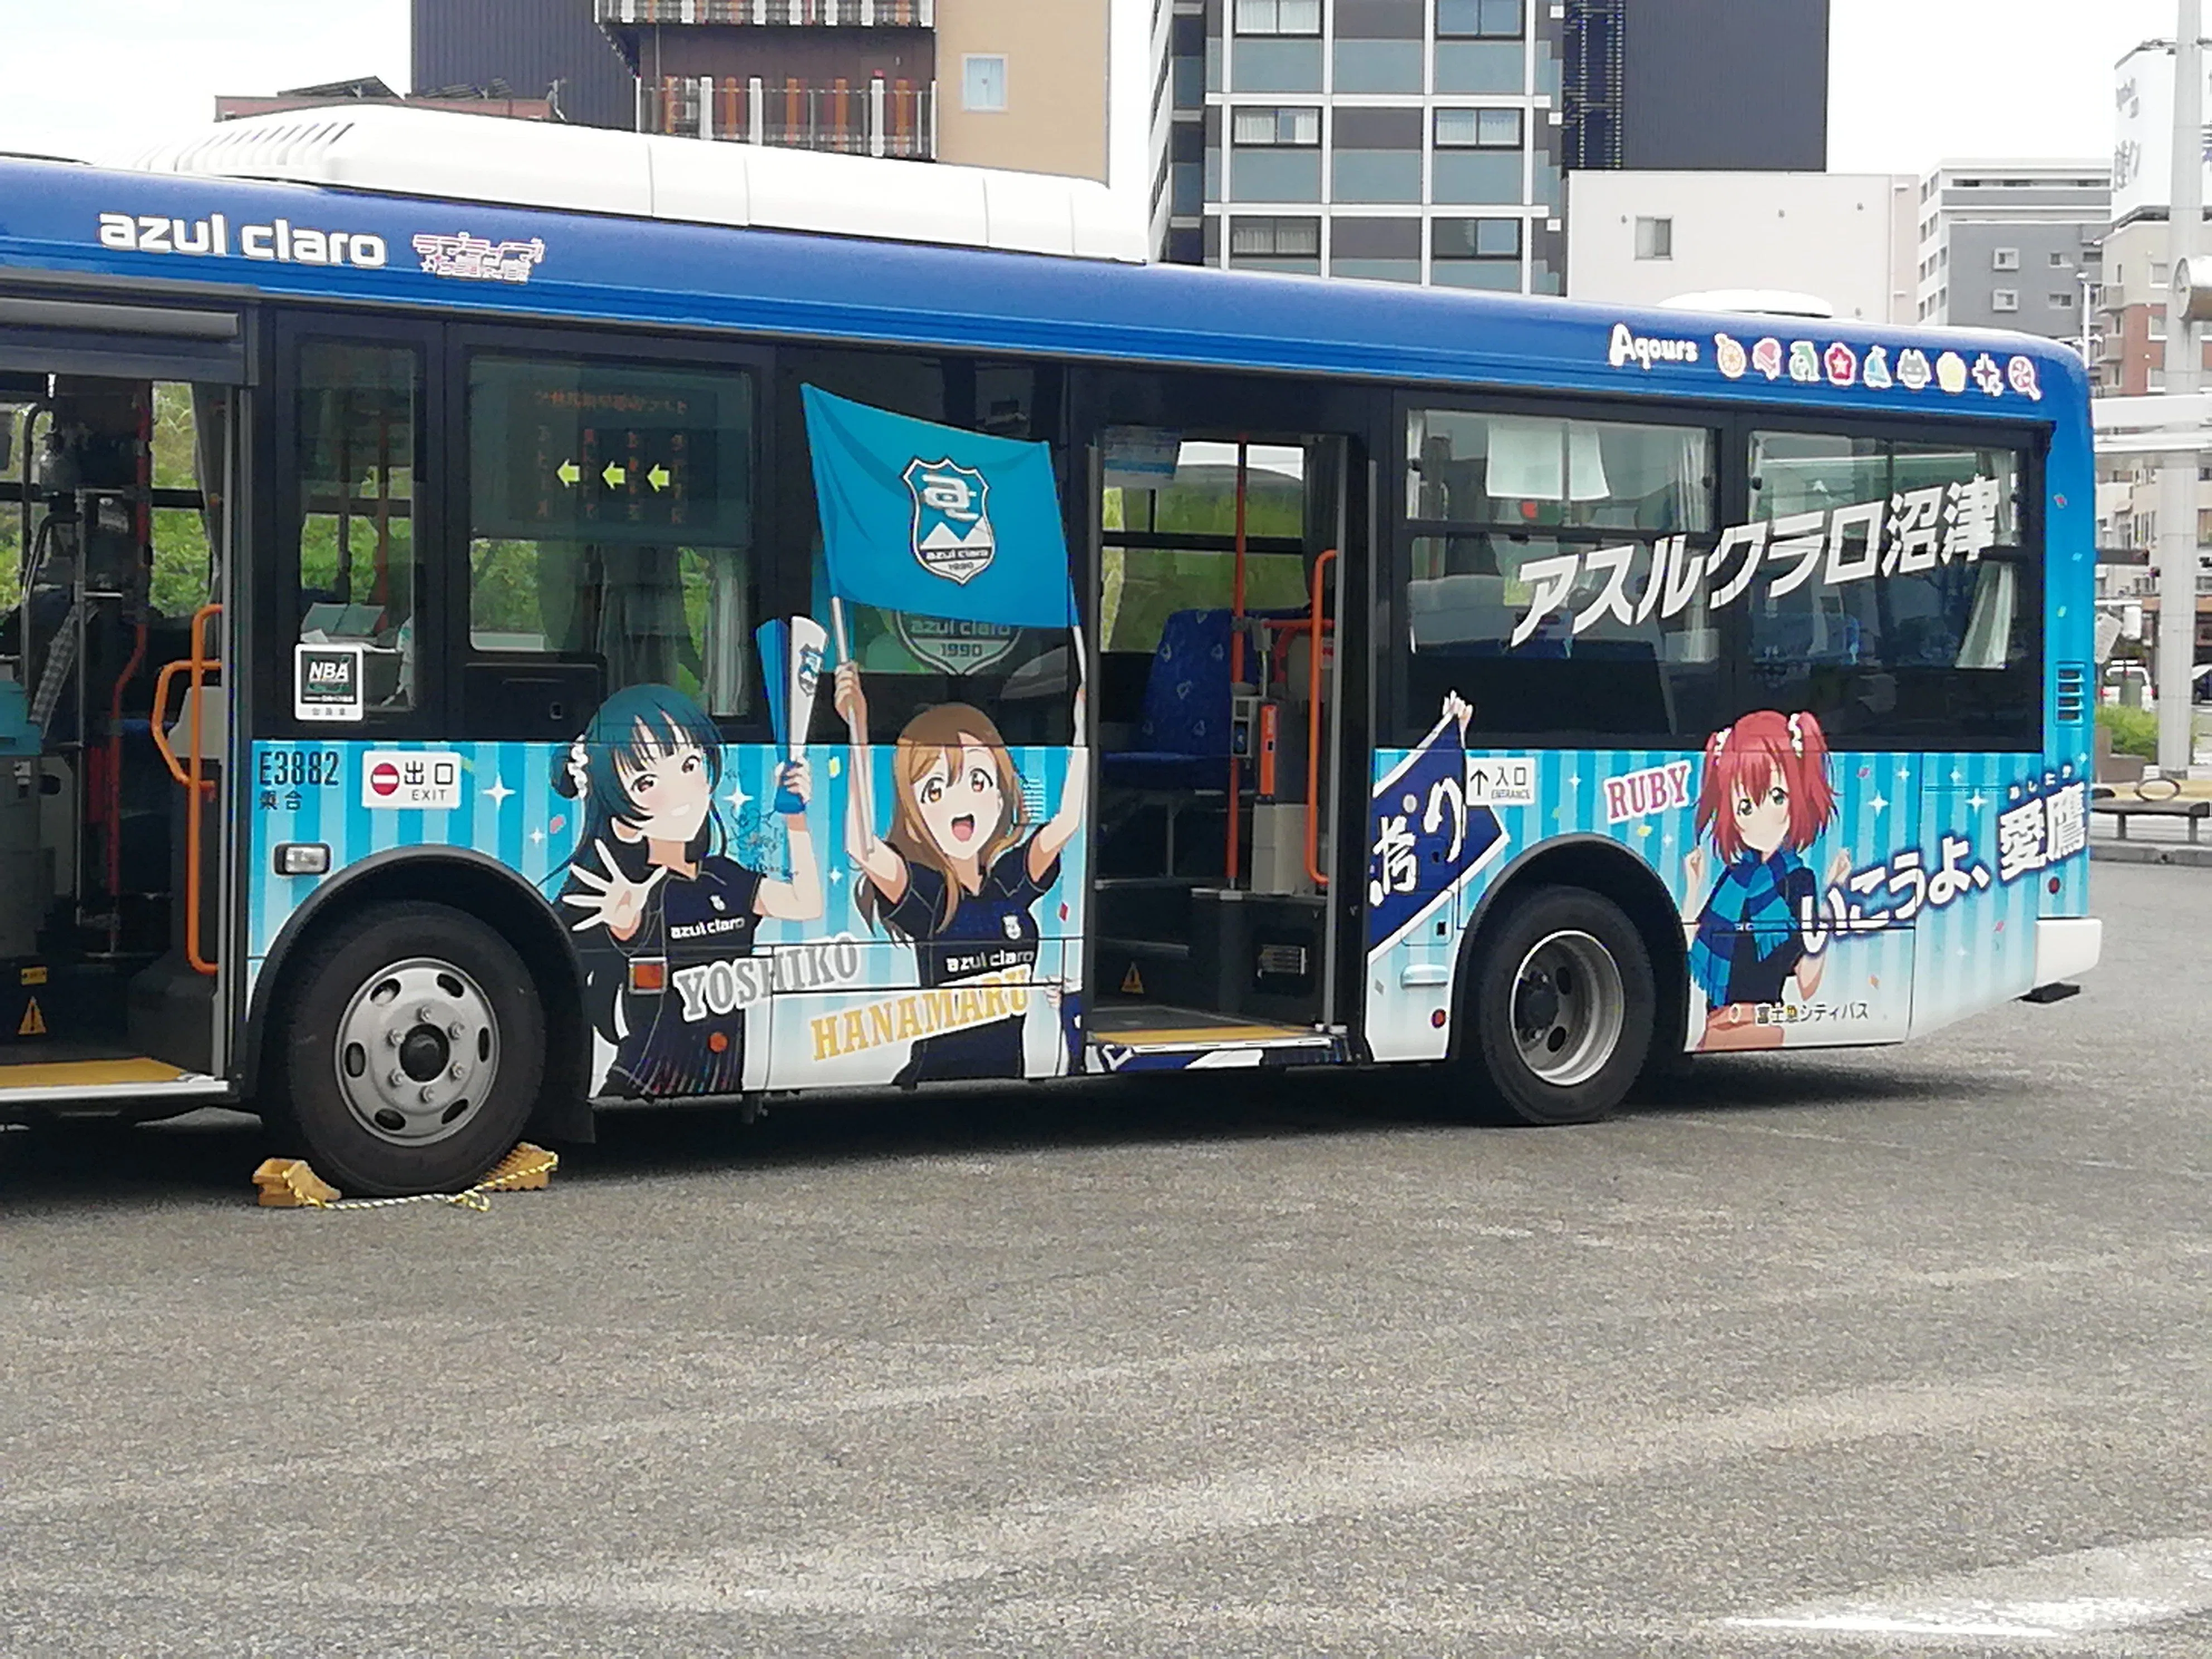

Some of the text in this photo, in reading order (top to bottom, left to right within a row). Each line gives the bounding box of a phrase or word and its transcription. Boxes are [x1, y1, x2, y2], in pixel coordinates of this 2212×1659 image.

[99, 212, 387, 268] azul claro
[1609, 323, 1698, 370] Aqours
[1511, 474, 2000, 648] アスルクラロ沼津
[911, 619, 1011, 636] azul claro
[940, 643, 983, 657] 1990
[309, 661, 349, 682] NBA
[259, 751, 339, 786] E3882
[404, 760, 454, 785] 出口
[1495, 766, 1526, 787] 入口
[411, 789, 447, 801] EXIT
[1607, 764, 1688, 819] RUBY
[671, 916, 745, 939] azul claro
[947, 948, 1035, 973] azul claro
[676, 936, 858, 1016] YOSHIKO
[810, 967, 1029, 1061] HANAMARU
